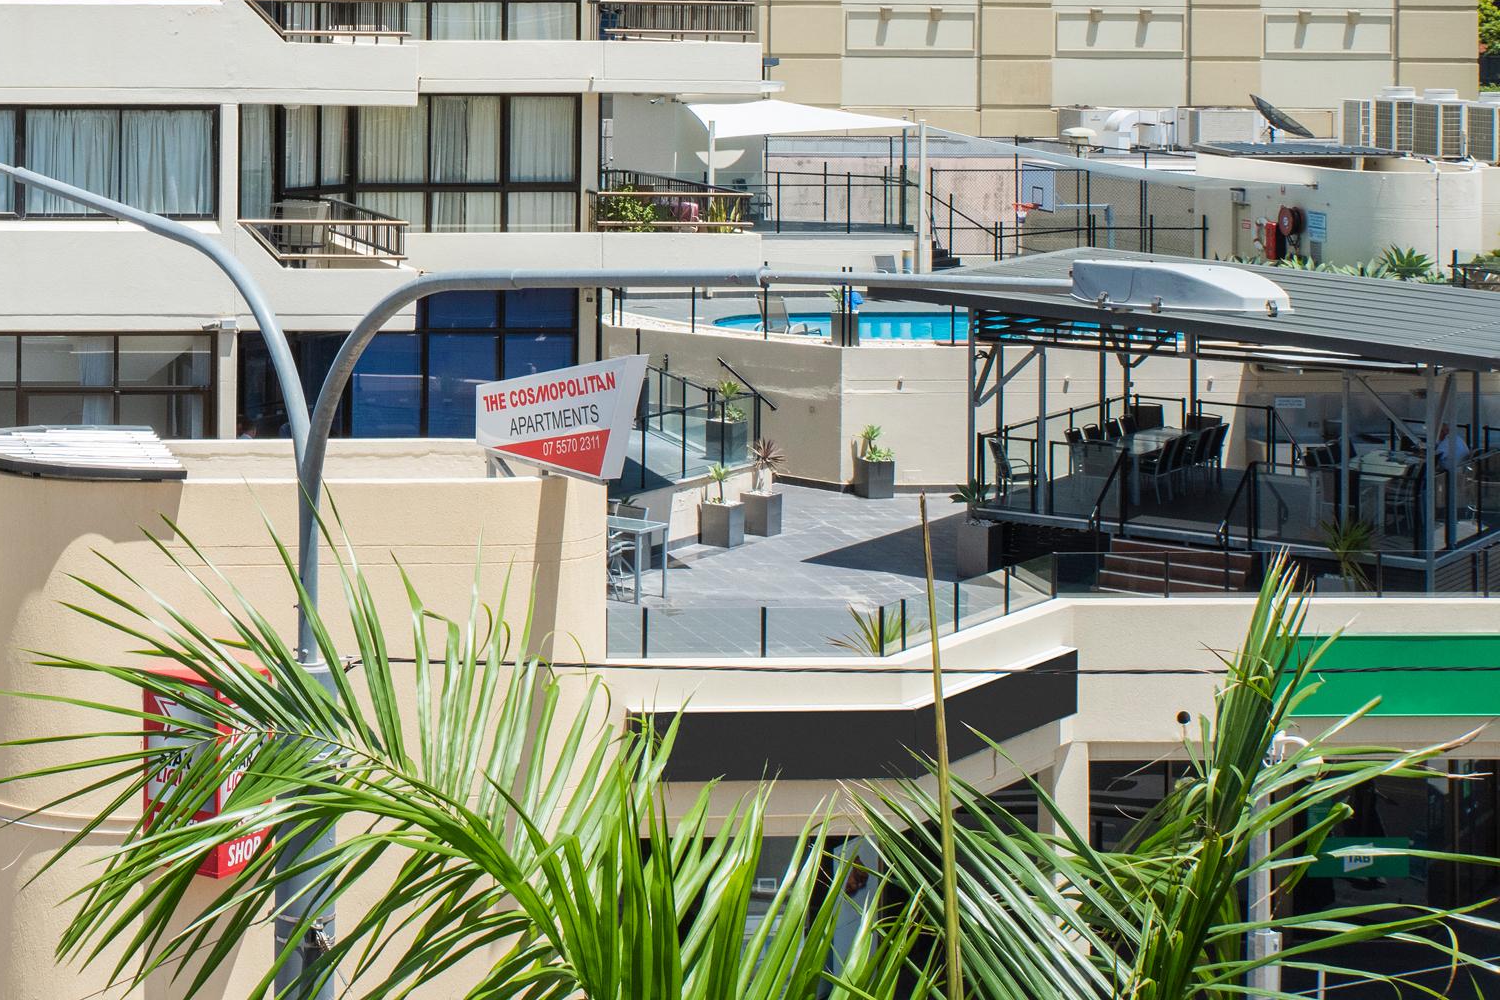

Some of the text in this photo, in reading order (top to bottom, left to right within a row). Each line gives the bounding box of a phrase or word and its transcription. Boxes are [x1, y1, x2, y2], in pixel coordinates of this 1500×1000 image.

[483, 372, 616, 413] THE COSMOPOLITAN
[510, 404, 600, 437] APARTMENTS
[542, 435, 601, 456] 07 5570 2311
[227, 835, 262, 867] SHOP
[1348, 853, 1372, 863] TAB
